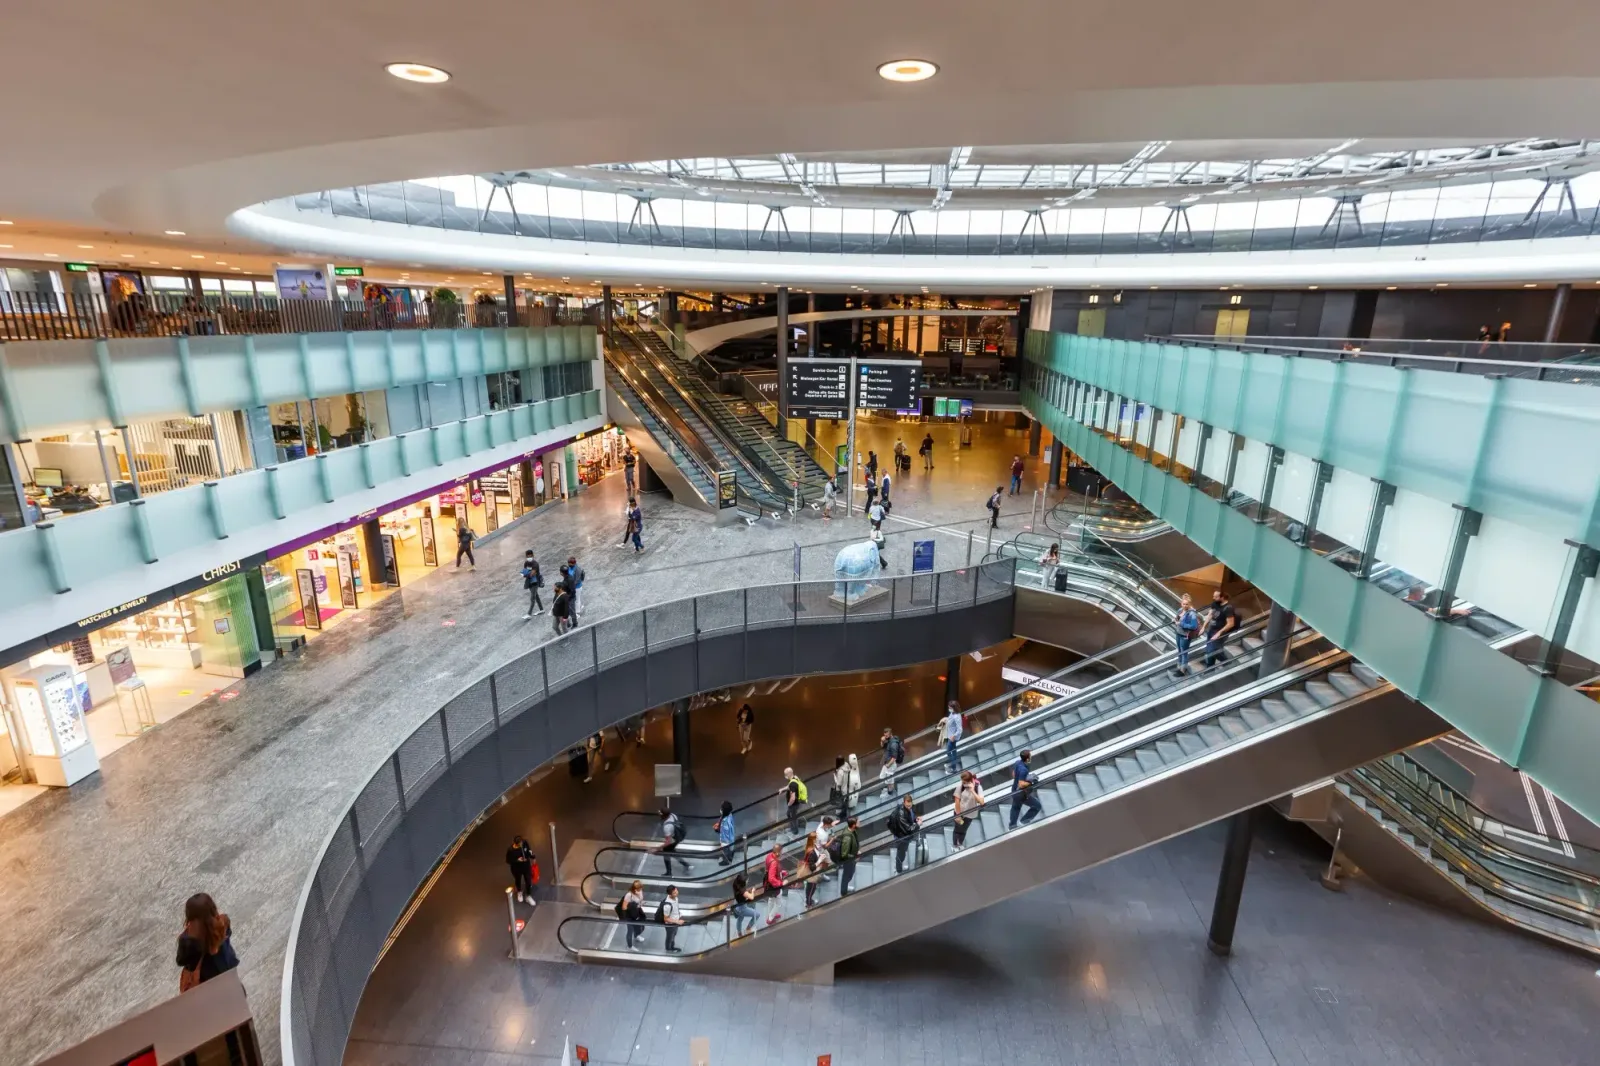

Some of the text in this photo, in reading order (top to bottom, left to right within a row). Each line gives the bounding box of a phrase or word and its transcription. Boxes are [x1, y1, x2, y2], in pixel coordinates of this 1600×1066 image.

[202, 559, 241, 581] CHRIST
[77, 596, 148, 628] WATCHES & JEWELRY
[45, 671, 67, 683] CASIO
